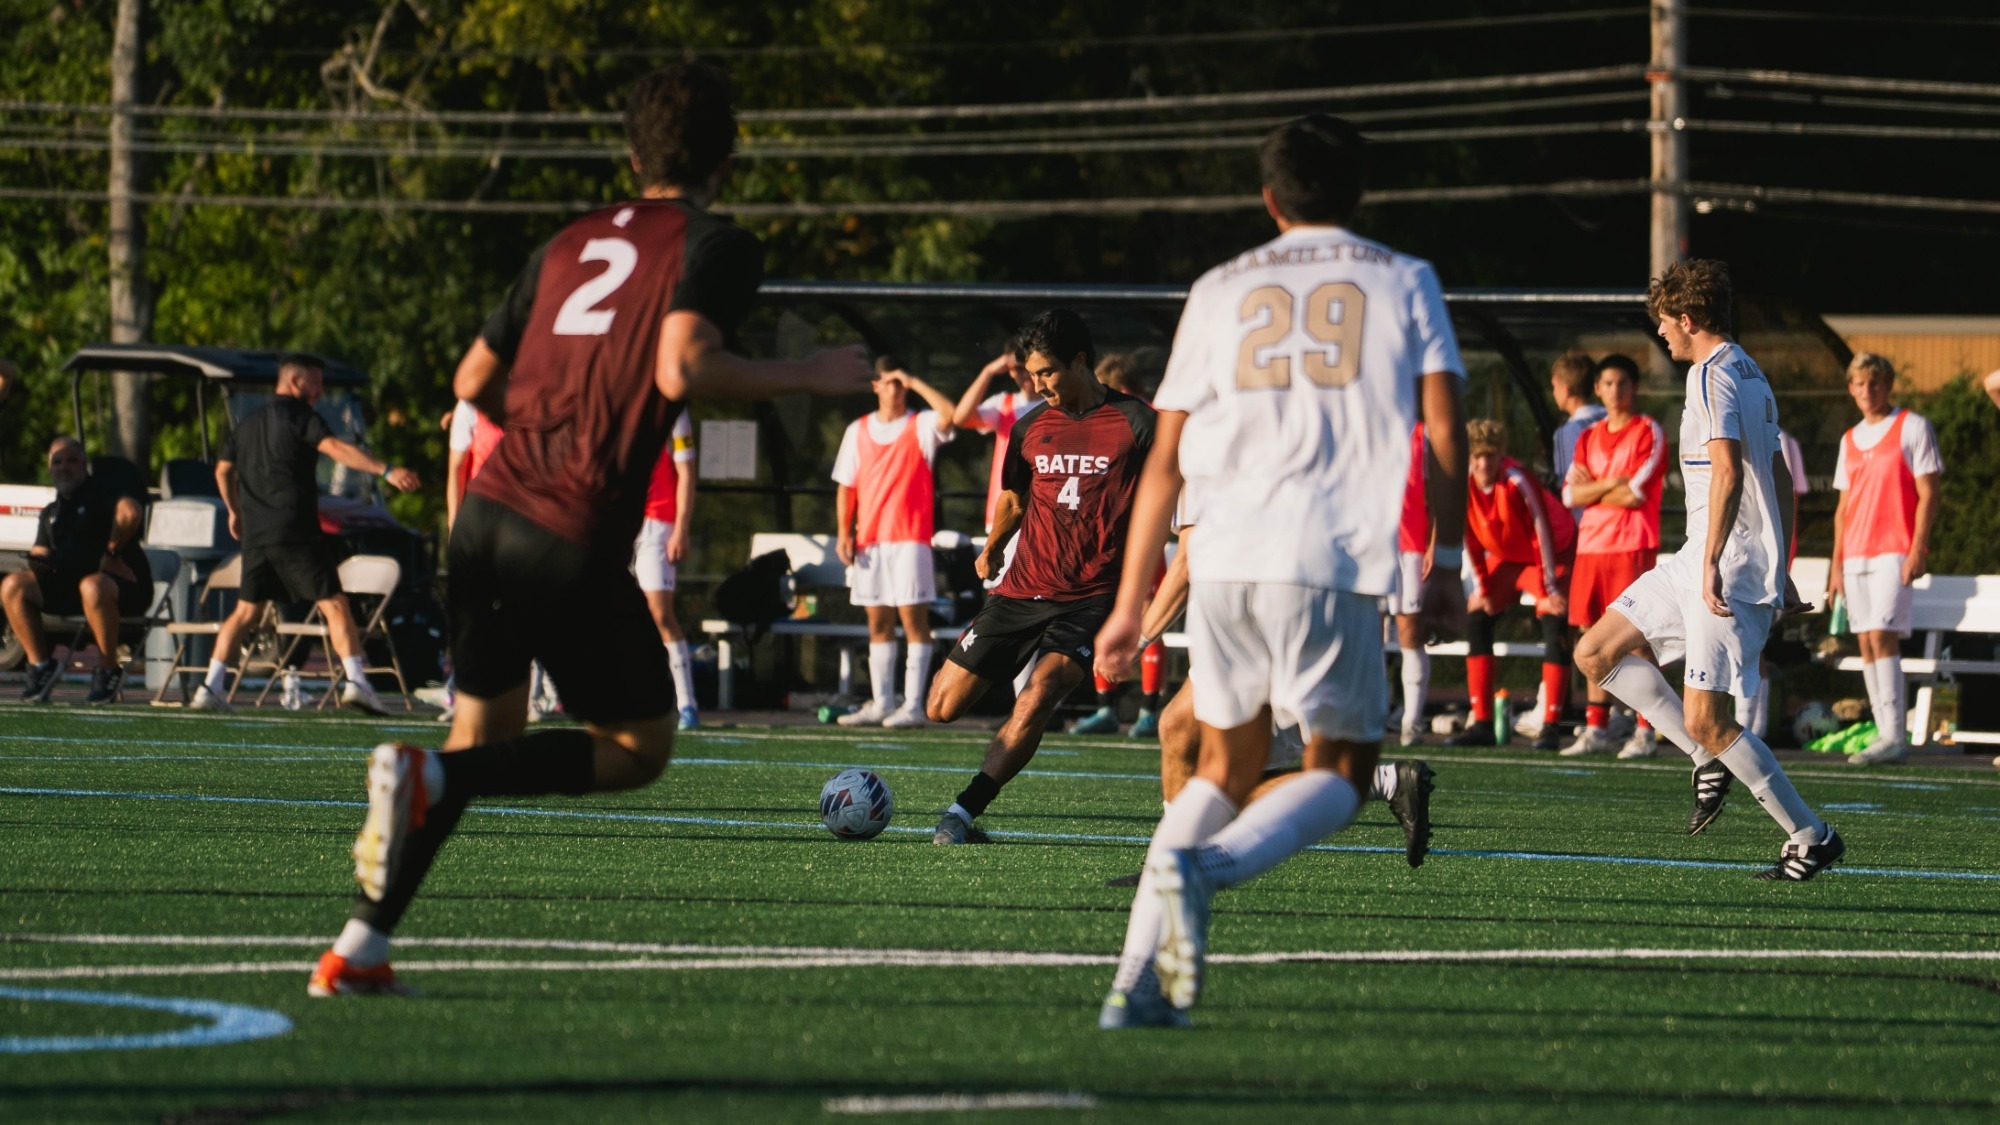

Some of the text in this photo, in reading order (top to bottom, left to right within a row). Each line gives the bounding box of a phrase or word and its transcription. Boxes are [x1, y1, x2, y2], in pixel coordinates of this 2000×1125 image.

[552, 237, 639, 336] 2
[1235, 281, 1366, 391] 29
[1035, 454, 1109, 475] BATES
[1056, 476, 1081, 510] 4
